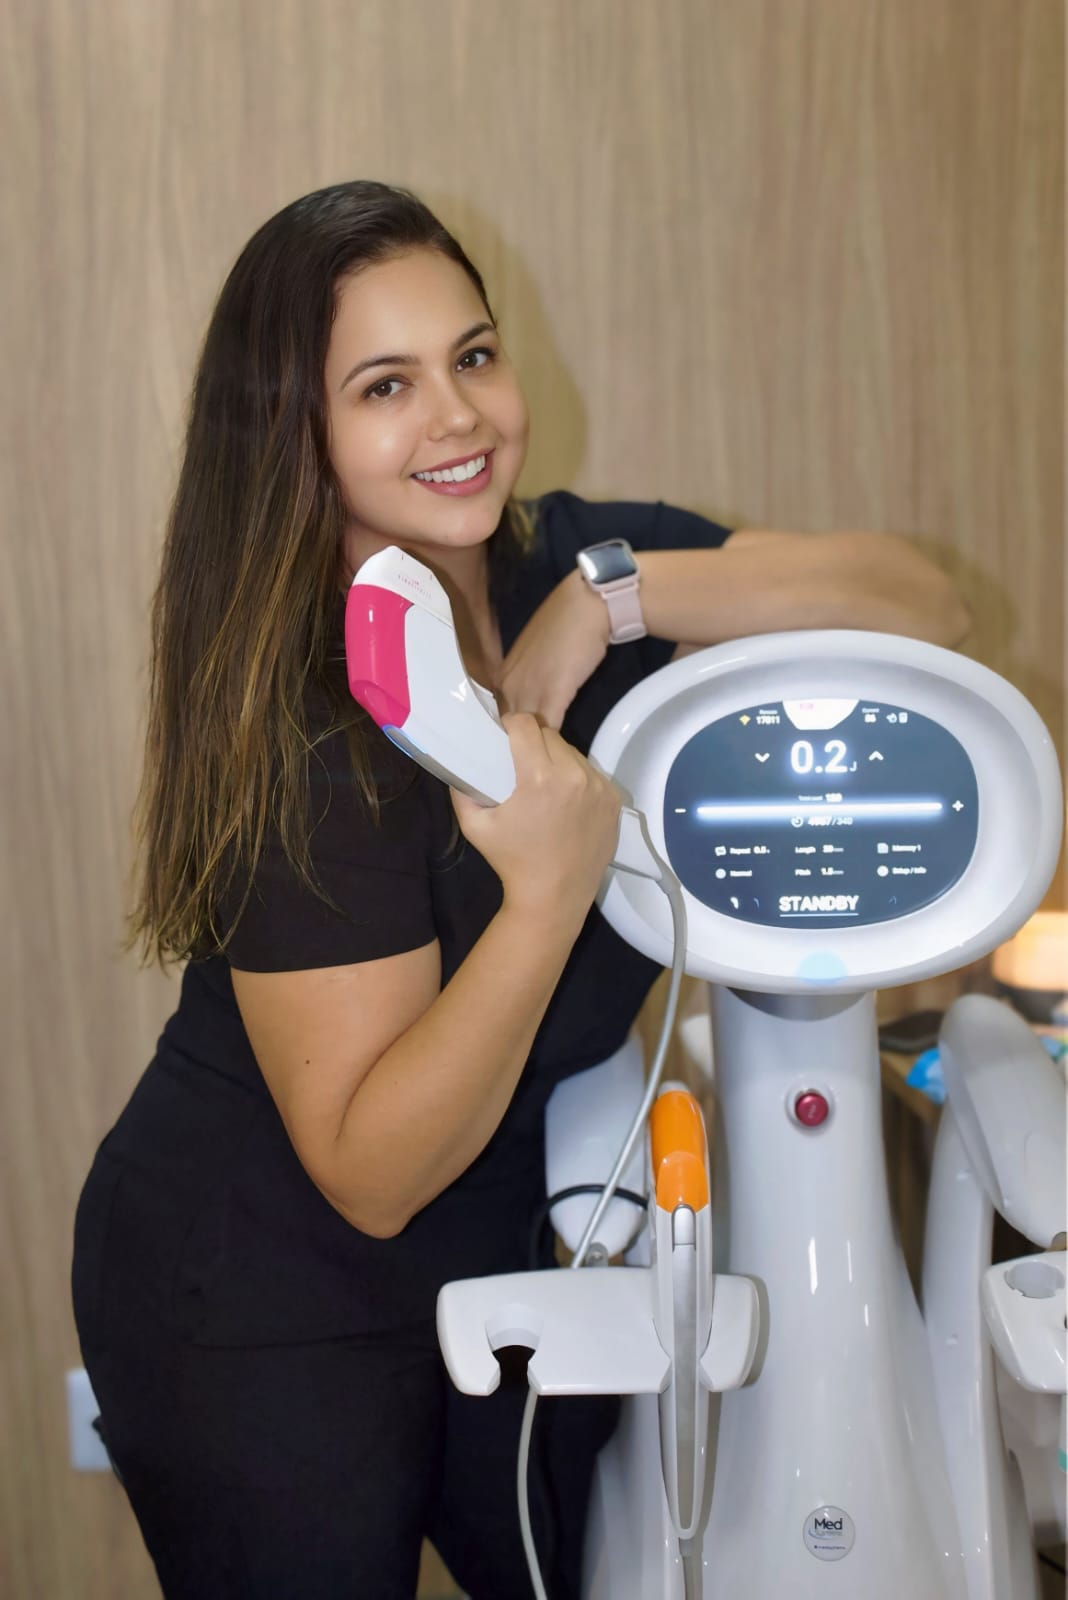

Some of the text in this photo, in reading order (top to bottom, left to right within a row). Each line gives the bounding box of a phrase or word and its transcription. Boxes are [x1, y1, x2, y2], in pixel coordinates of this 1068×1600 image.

[790, 739, 848, 774] 0.2
[779, 895, 859, 912] STANDBY
[814, 1517, 843, 1530] Med
